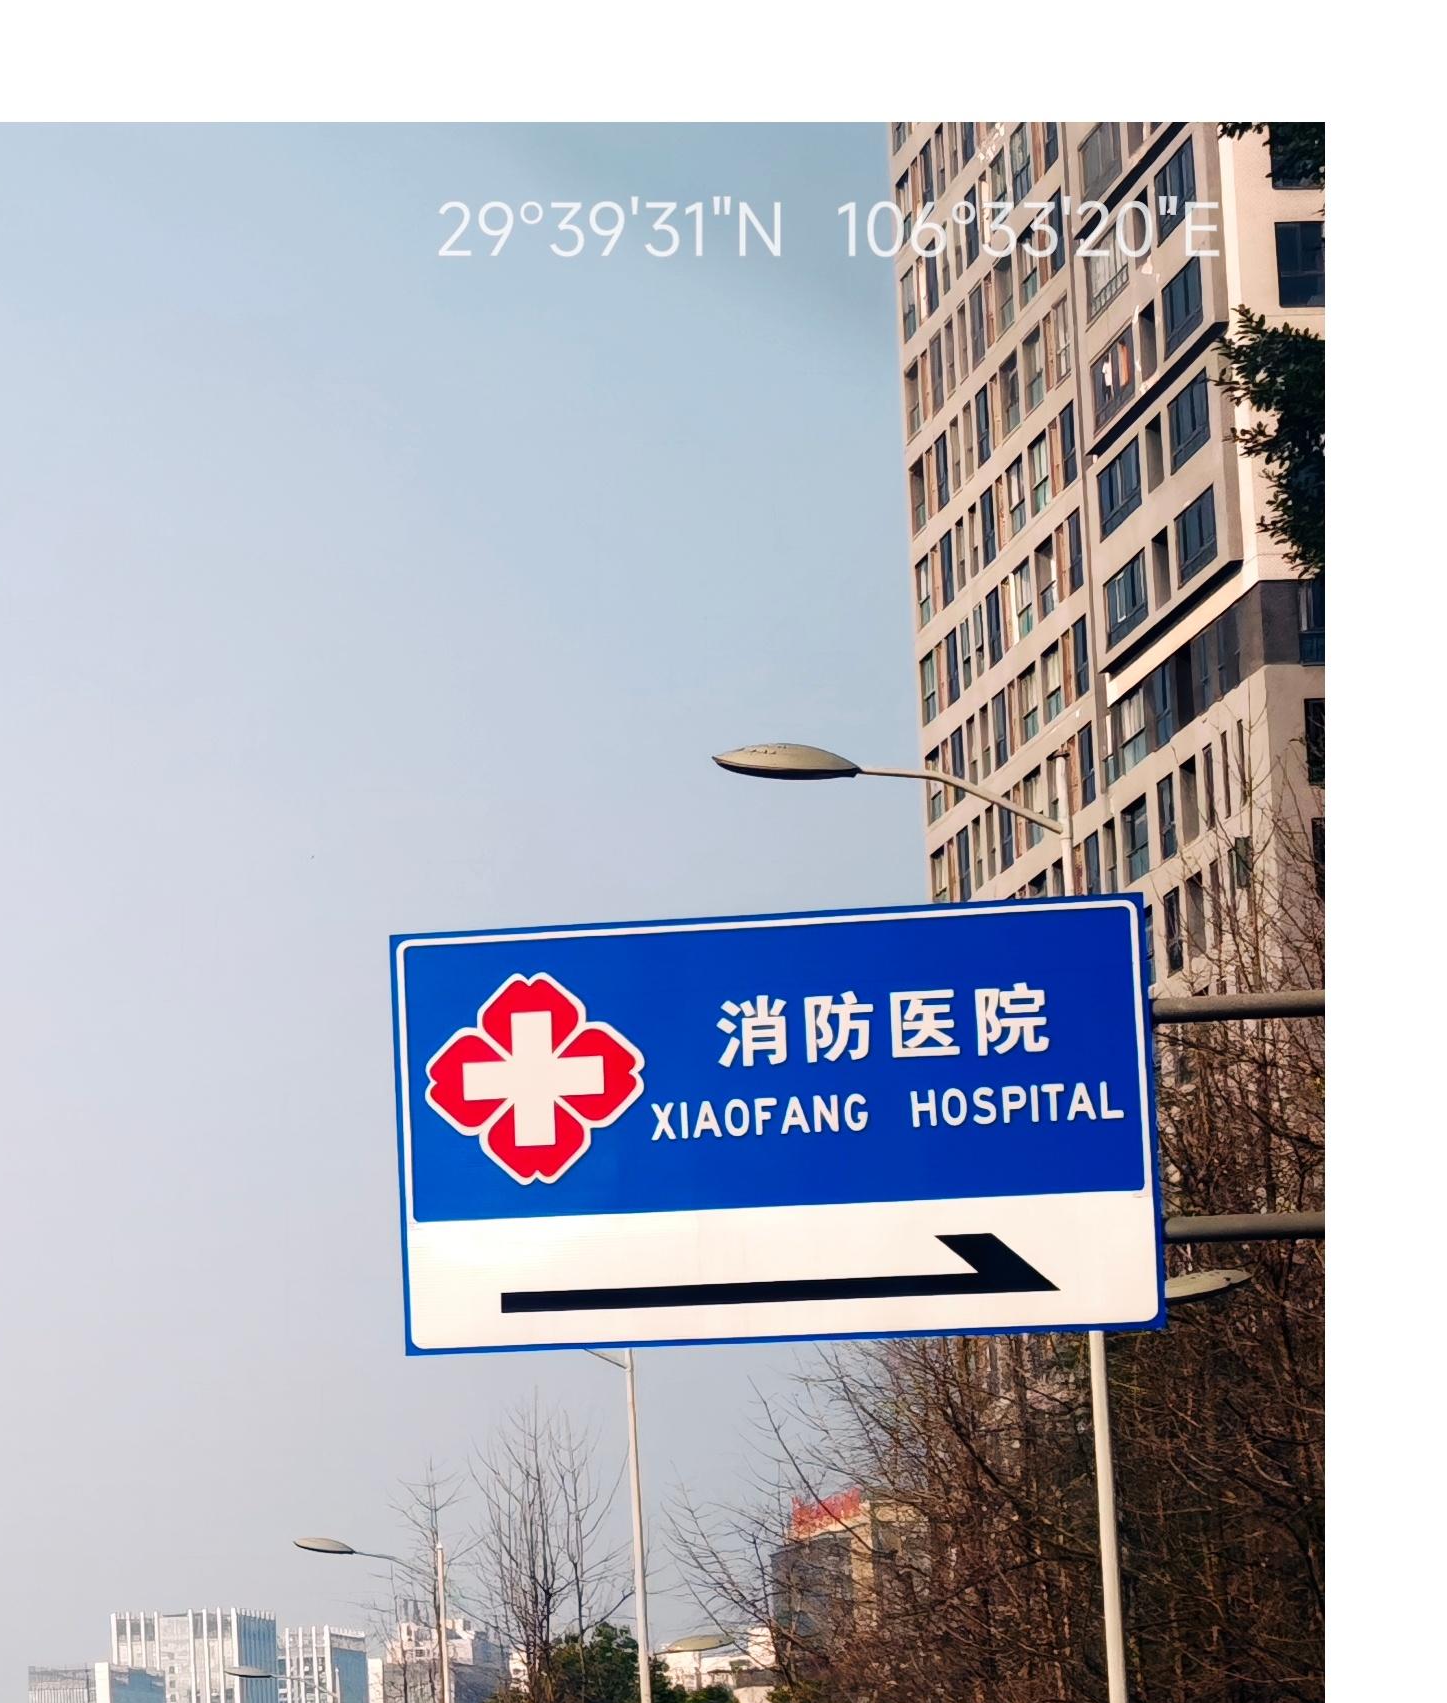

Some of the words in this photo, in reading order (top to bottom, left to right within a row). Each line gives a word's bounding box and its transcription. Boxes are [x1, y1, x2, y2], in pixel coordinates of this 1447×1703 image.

[716, 982, 1050, 1068] 消防医院
[651, 1093, 869, 1141] XIAOFANG
[910, 1081, 1125, 1129] HOSPITAL
